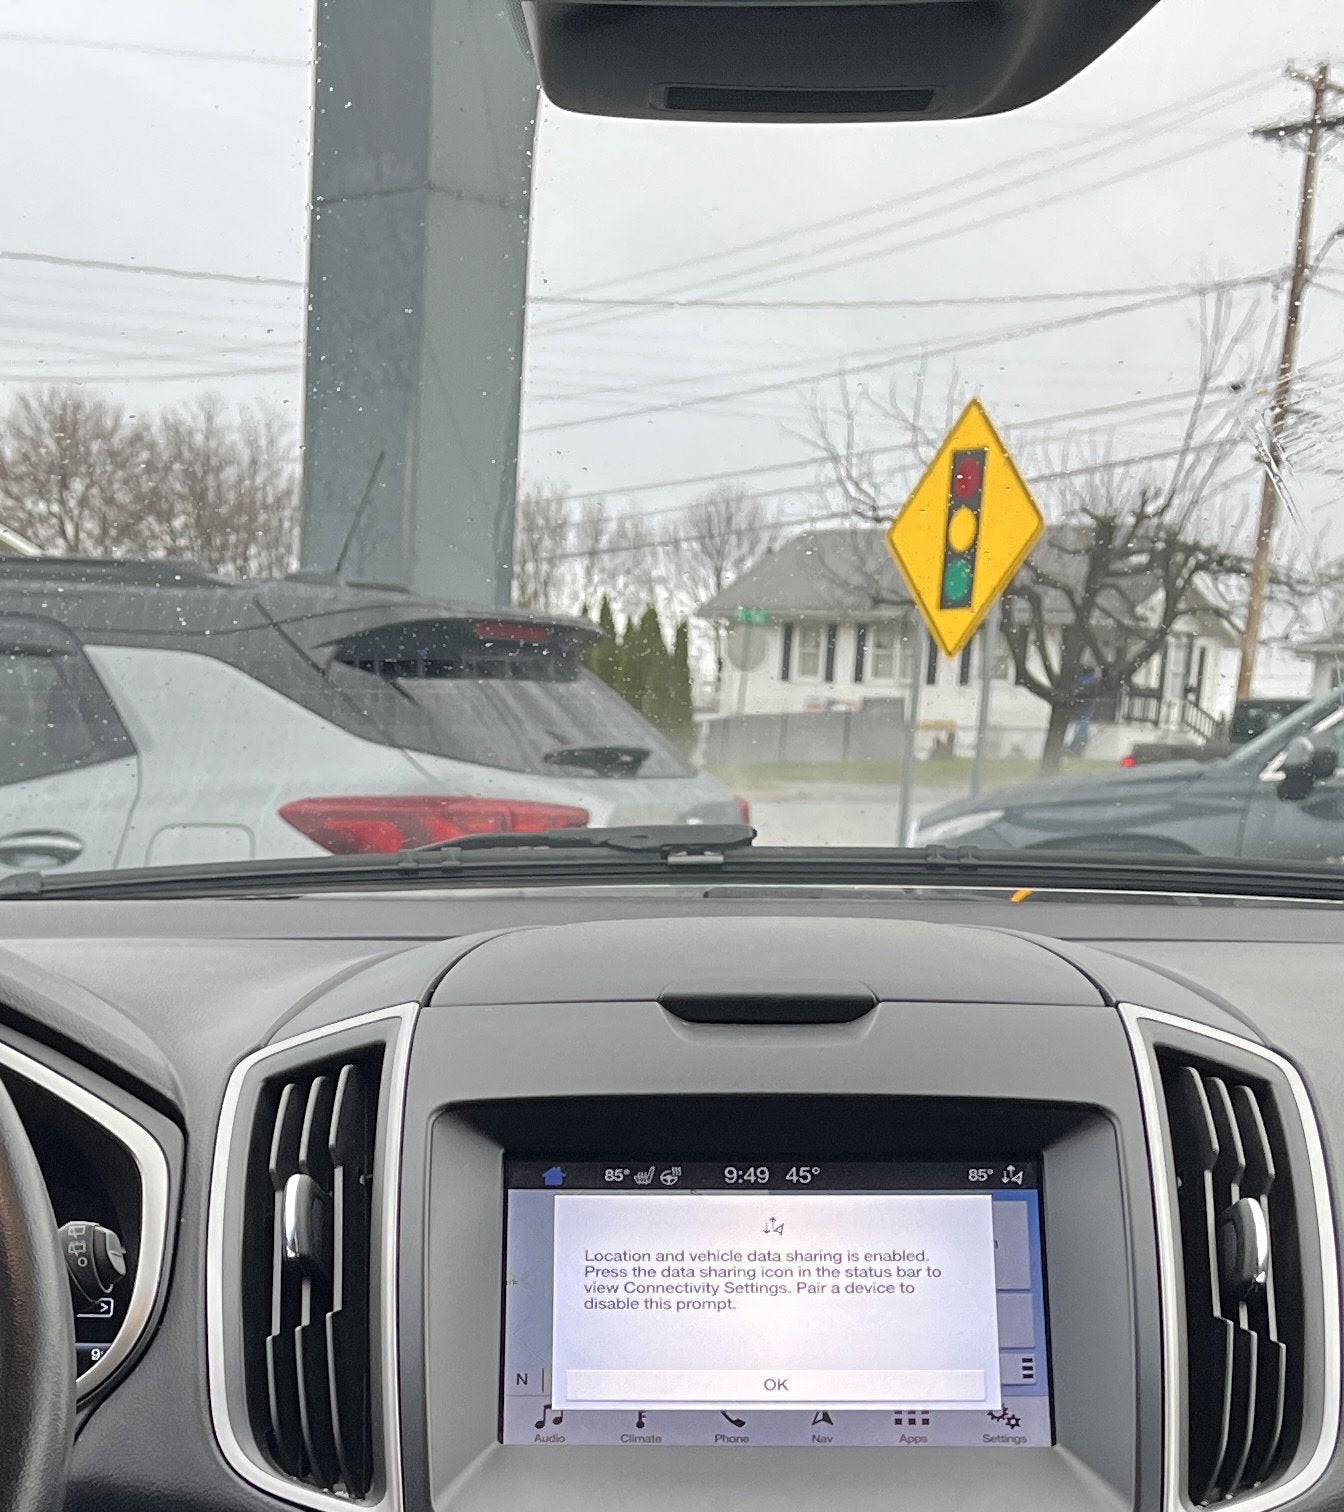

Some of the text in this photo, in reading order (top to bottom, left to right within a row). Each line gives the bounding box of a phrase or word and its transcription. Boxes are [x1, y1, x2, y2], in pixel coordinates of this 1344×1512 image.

[724, 1167, 769, 1184] 9:49
[785, 1166, 821, 1184] 45°
[585, 1250, 929, 1265] Location and vehicle data sharing is enabled.
[585, 1266, 942, 1281] Press the data sharing icon in the status bar to
[584, 1281, 915, 1297] view Connectivity Settings. Pair a device to
[584, 1297, 737, 1313] disable this prompt.
[516, 1373, 529, 1386] N
[764, 1379, 789, 1391] OK
[534, 1434, 566, 1444] Audio
[620, 1434, 662, 1444] Climate
[714, 1434, 750, 1444] Phone
[811, 1434, 834, 1444] Nav
[899, 1434, 928, 1445] Apps
[982, 1434, 1027, 1445] Settings
